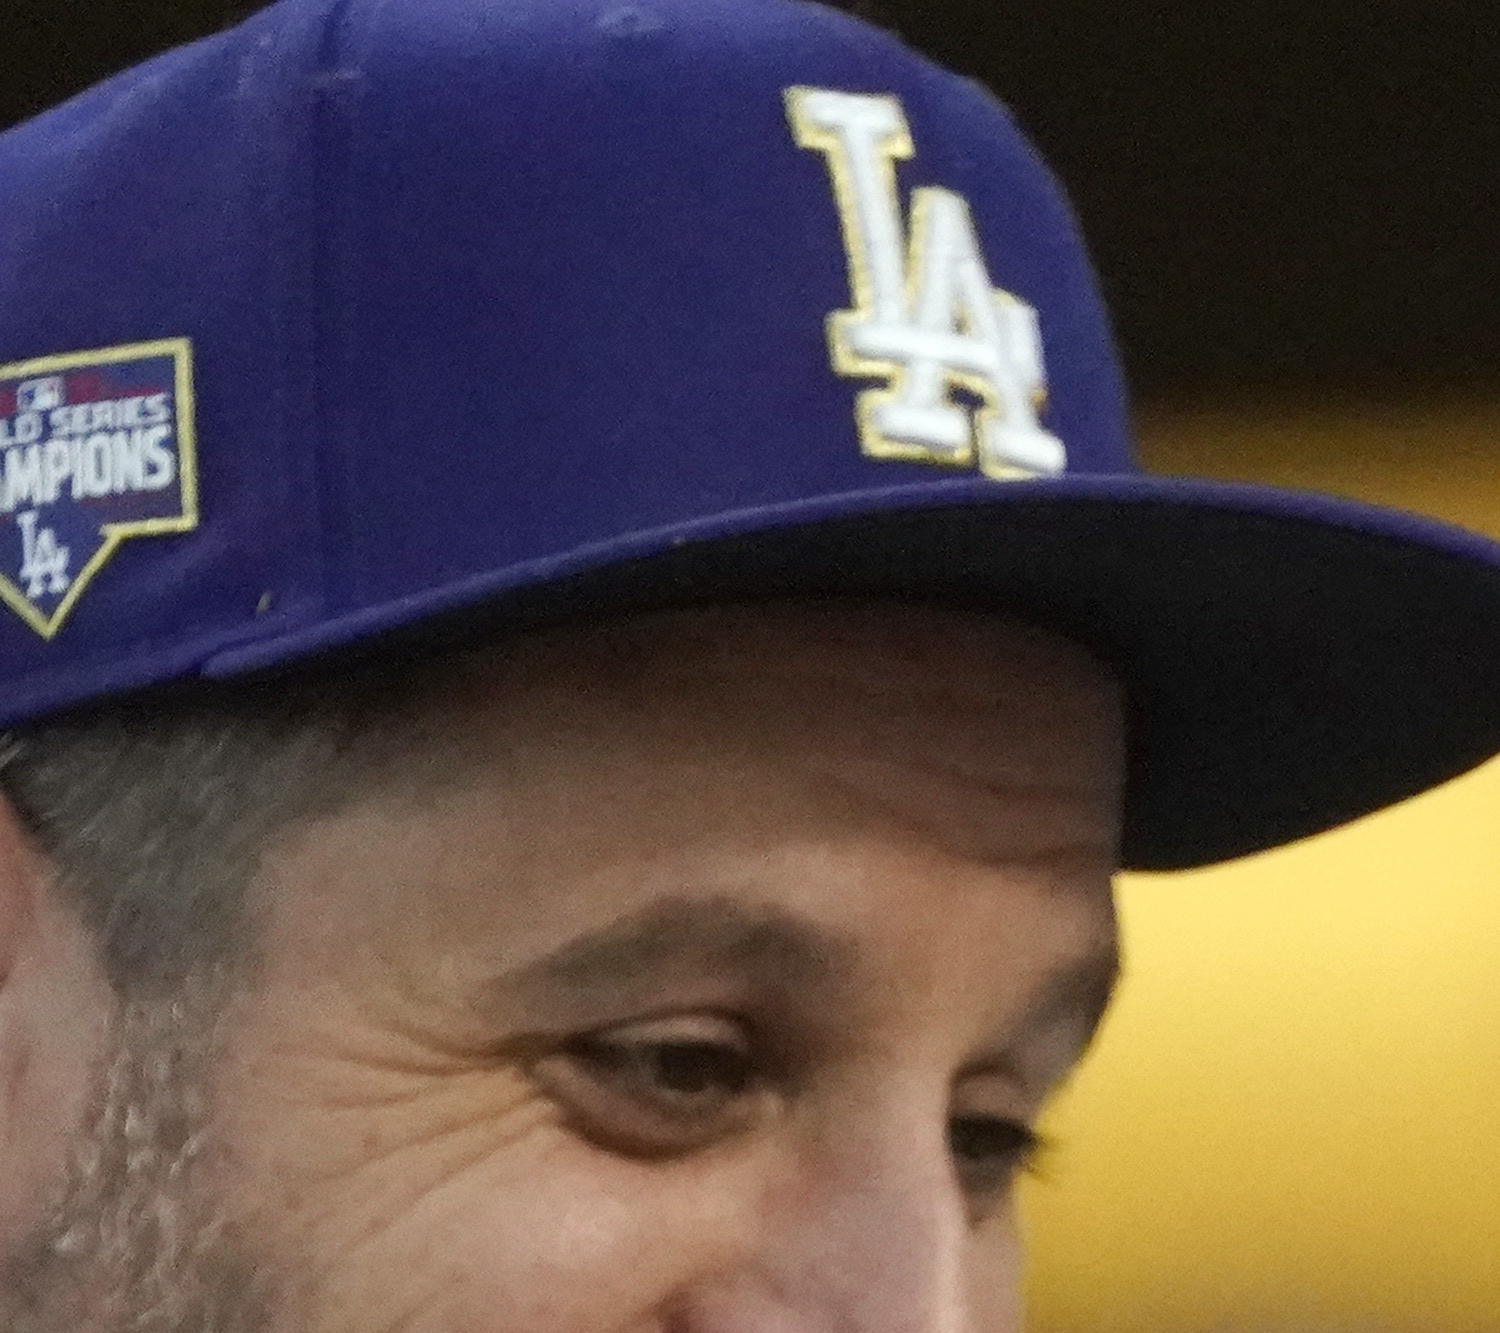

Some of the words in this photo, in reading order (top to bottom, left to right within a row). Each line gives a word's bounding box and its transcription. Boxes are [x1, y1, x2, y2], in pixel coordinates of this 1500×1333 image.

[782, 84, 1067, 480] LA
[50, 392, 173, 436] SERIES
[16, 509, 70, 599] LA
